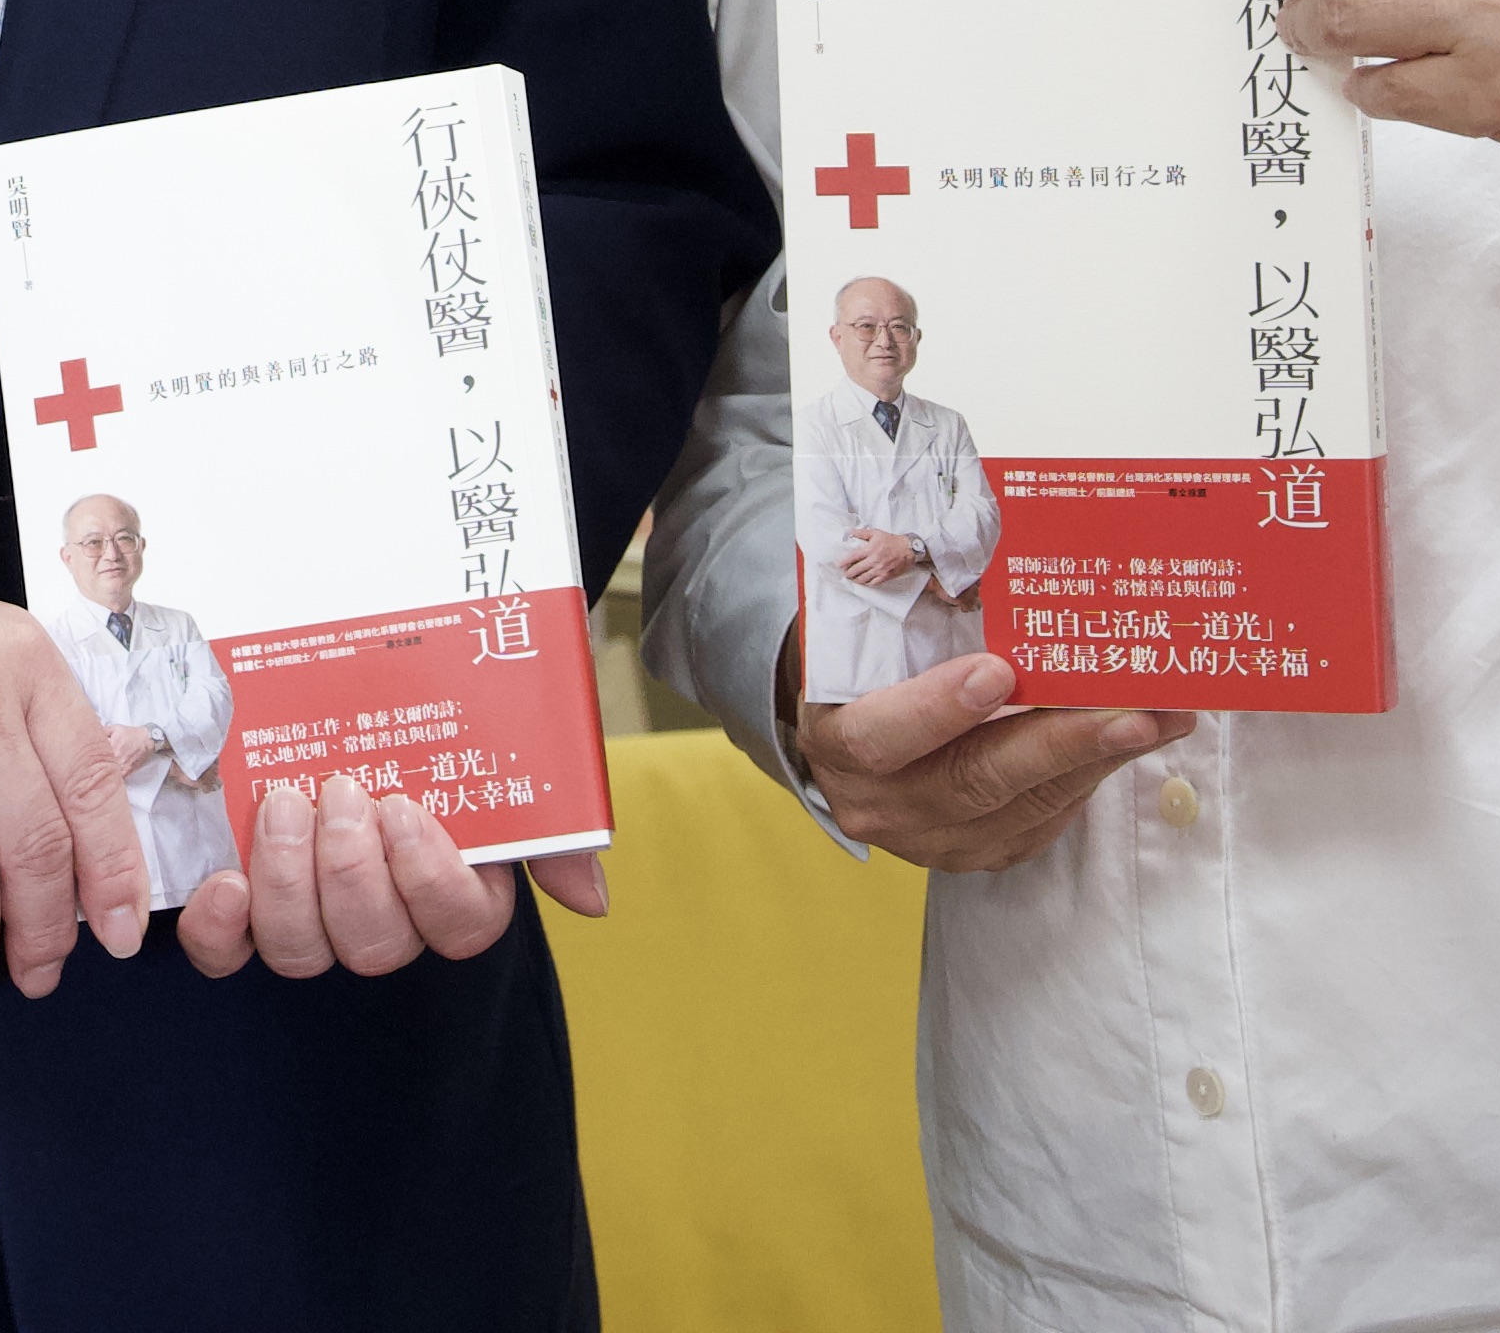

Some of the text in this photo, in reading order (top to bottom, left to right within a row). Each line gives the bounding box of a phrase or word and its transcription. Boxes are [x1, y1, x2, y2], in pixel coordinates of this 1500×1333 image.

[937, 163, 1188, 190] 吳明賢的與善同行之路
[6, 175, 34, 242] 吳明賢
[148, 345, 380, 403] 吳明賢的與善同行之路
[1012, 607, 1296, 642] 「把自己活成一道光」，
[1011, 642, 1330, 678] 守護最多數人的大幸福。
